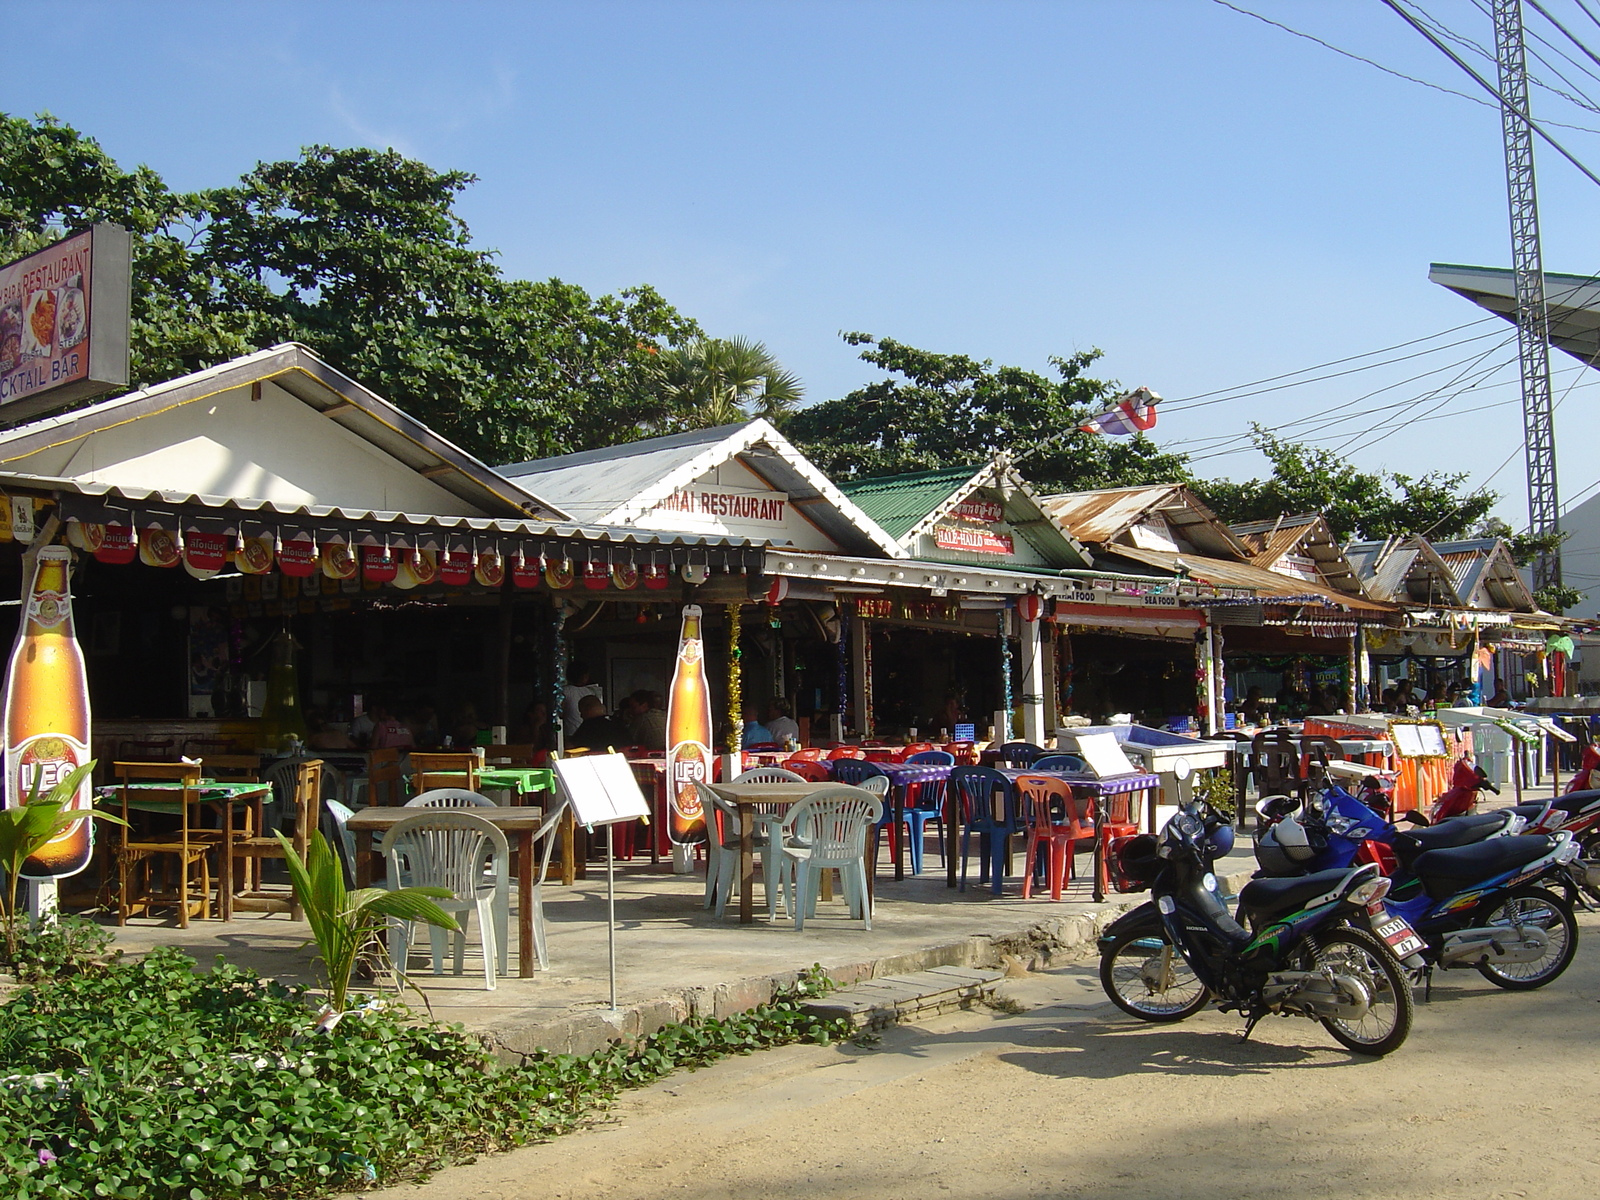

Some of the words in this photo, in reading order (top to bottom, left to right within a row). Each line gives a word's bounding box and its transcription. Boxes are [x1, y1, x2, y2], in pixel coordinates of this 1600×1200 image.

[22, 248, 89, 298] RESTAURANT
[22, 349, 43, 364] PASTA
[0, 366, 46, 400] CKTAIL
[52, 353, 79, 380] BAR
[651, 491, 694, 513] AMAI
[700, 492, 785, 521] RESTAURANT
[1076, 591, 1095, 601] FOOD
[1144, 596, 1157, 605] SEA
[1159, 597, 1175, 605] FOOD
[21, 762, 77, 791] LEO
[674, 761, 705, 782] LEO
[1400, 940, 1414, 952] 47
